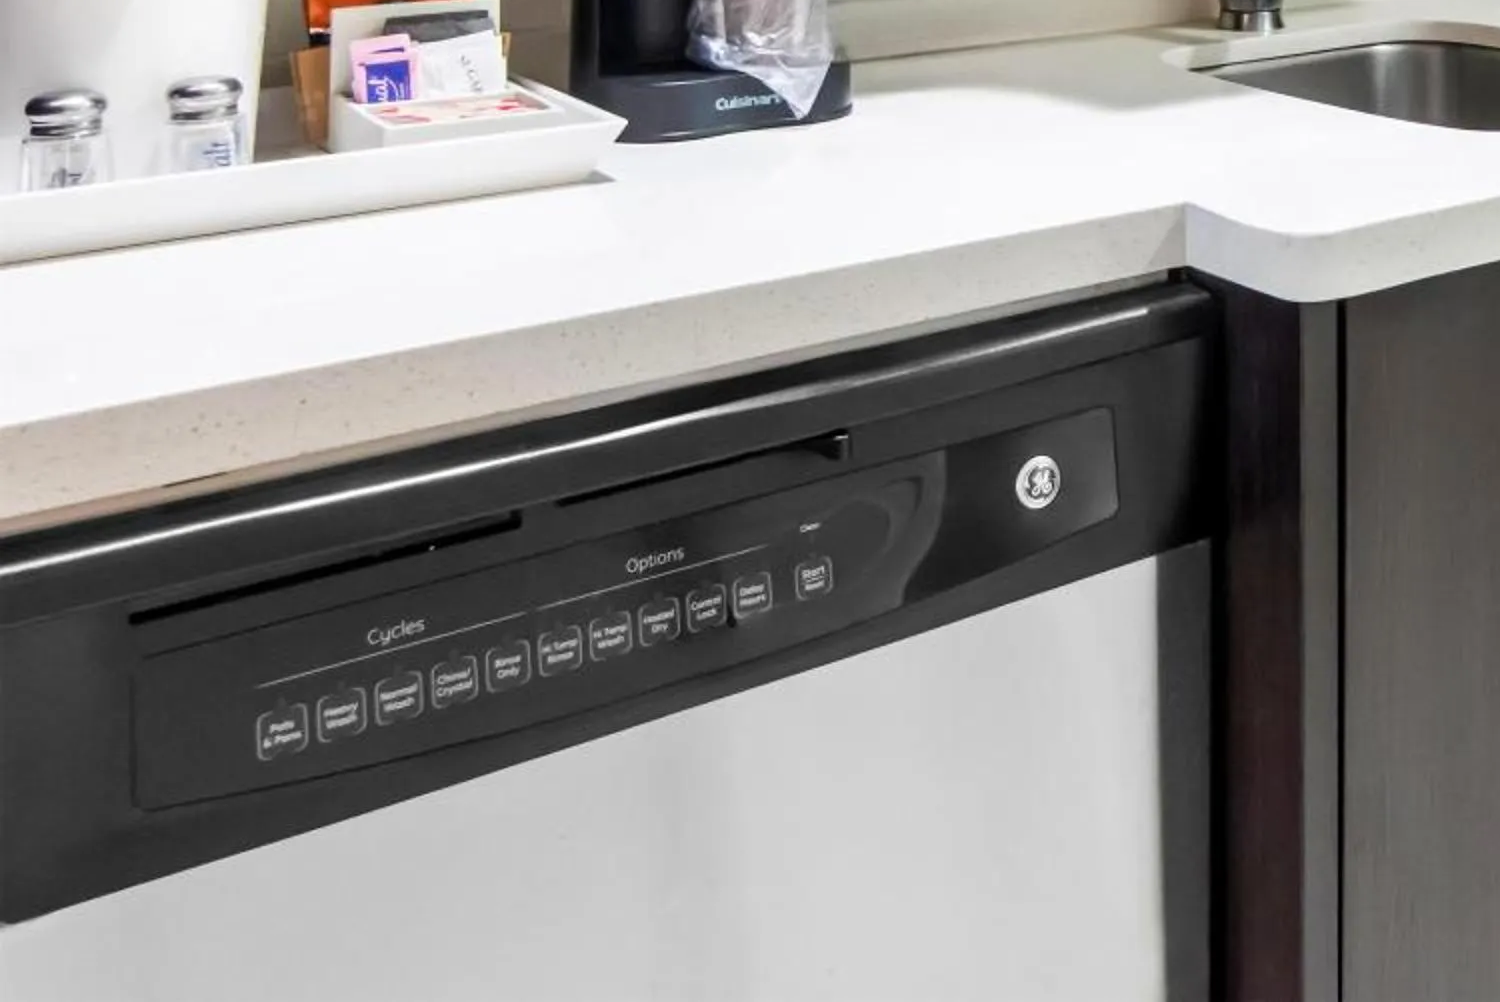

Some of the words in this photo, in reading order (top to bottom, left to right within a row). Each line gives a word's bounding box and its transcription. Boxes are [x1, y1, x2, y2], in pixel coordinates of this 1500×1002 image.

[715, 94, 781, 111] Cuisinar
[625, 547, 685, 574] Options
[367, 619, 426, 646] Cycles
